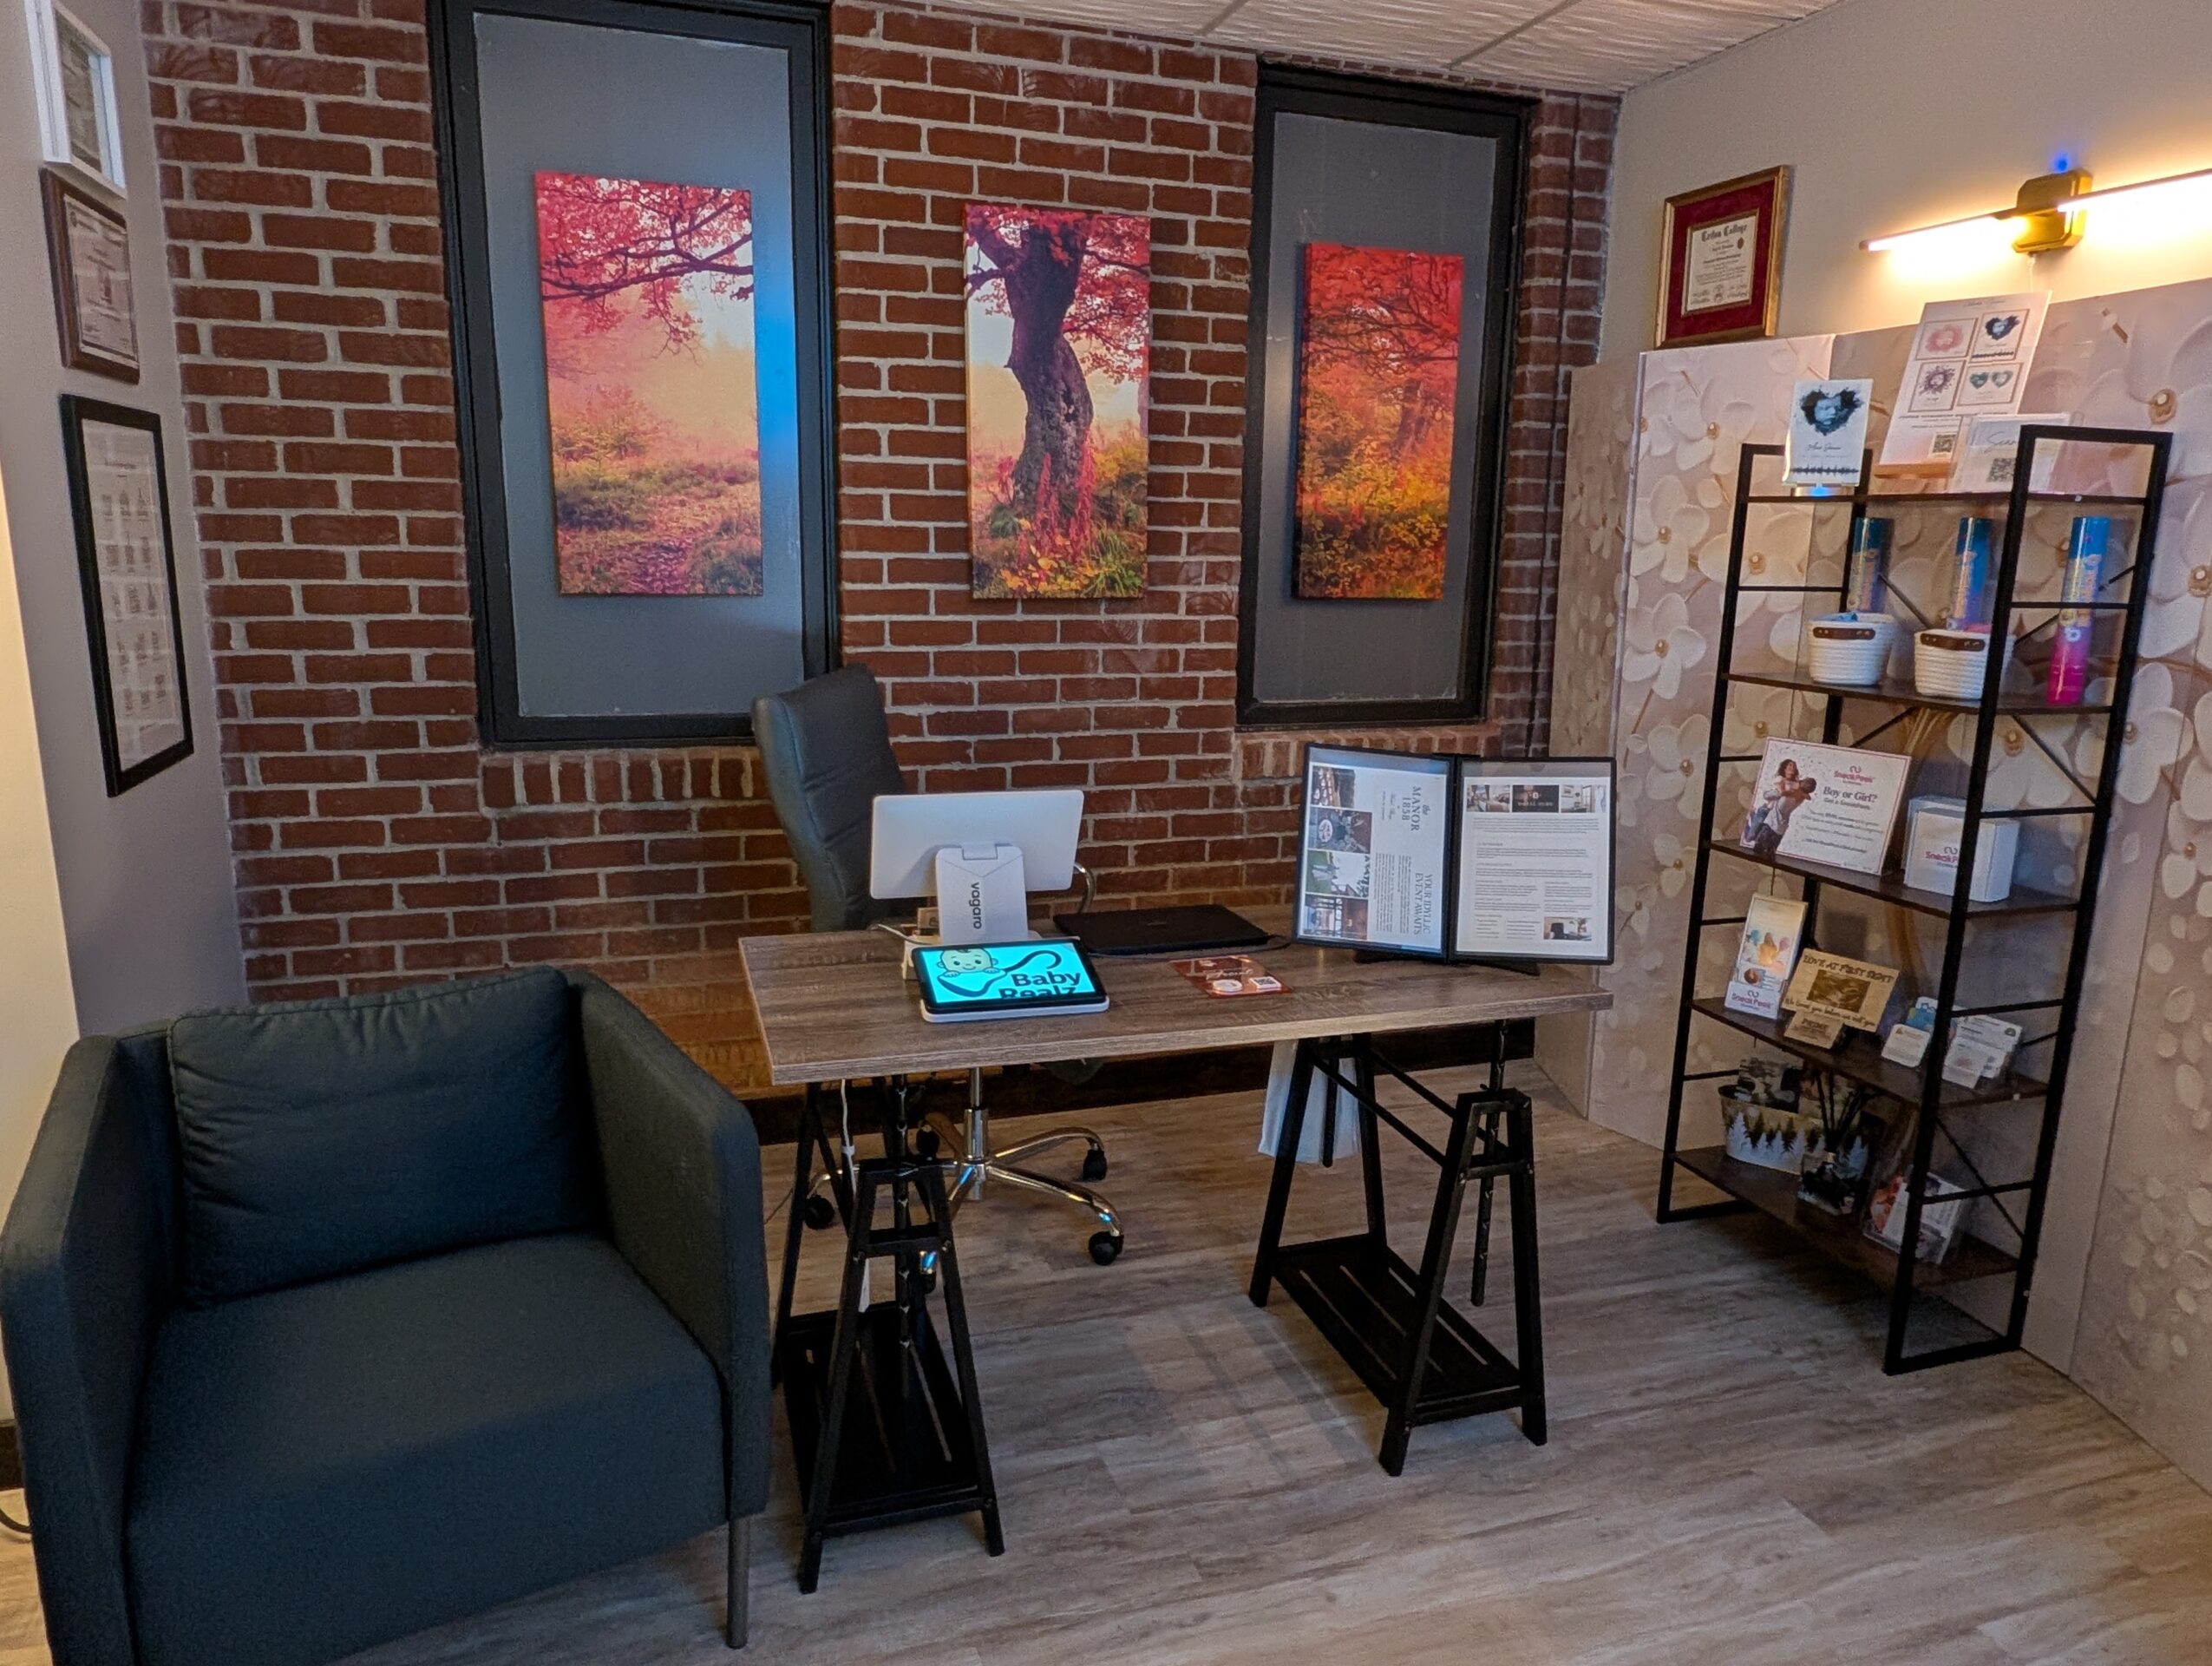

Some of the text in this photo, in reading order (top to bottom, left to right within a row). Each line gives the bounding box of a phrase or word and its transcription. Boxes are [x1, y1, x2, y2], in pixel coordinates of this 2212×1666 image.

[1410, 786, 1422, 831] MANOR
[1823, 786, 1840, 798] Boy
[1854, 791, 1878, 803] Girl?
[1402, 797, 1411, 821] 1858
[1423, 804, 1431, 816] the
[969, 882, 982, 929] vagaro
[1414, 872, 1423, 935] EVENT AWAITS
[1423, 874, 1433, 935] YOUR IDYLLIC
[1011, 971, 1081, 987] Baby
[1803, 955, 1895, 983] LOVE AT FIRST SIGHT
